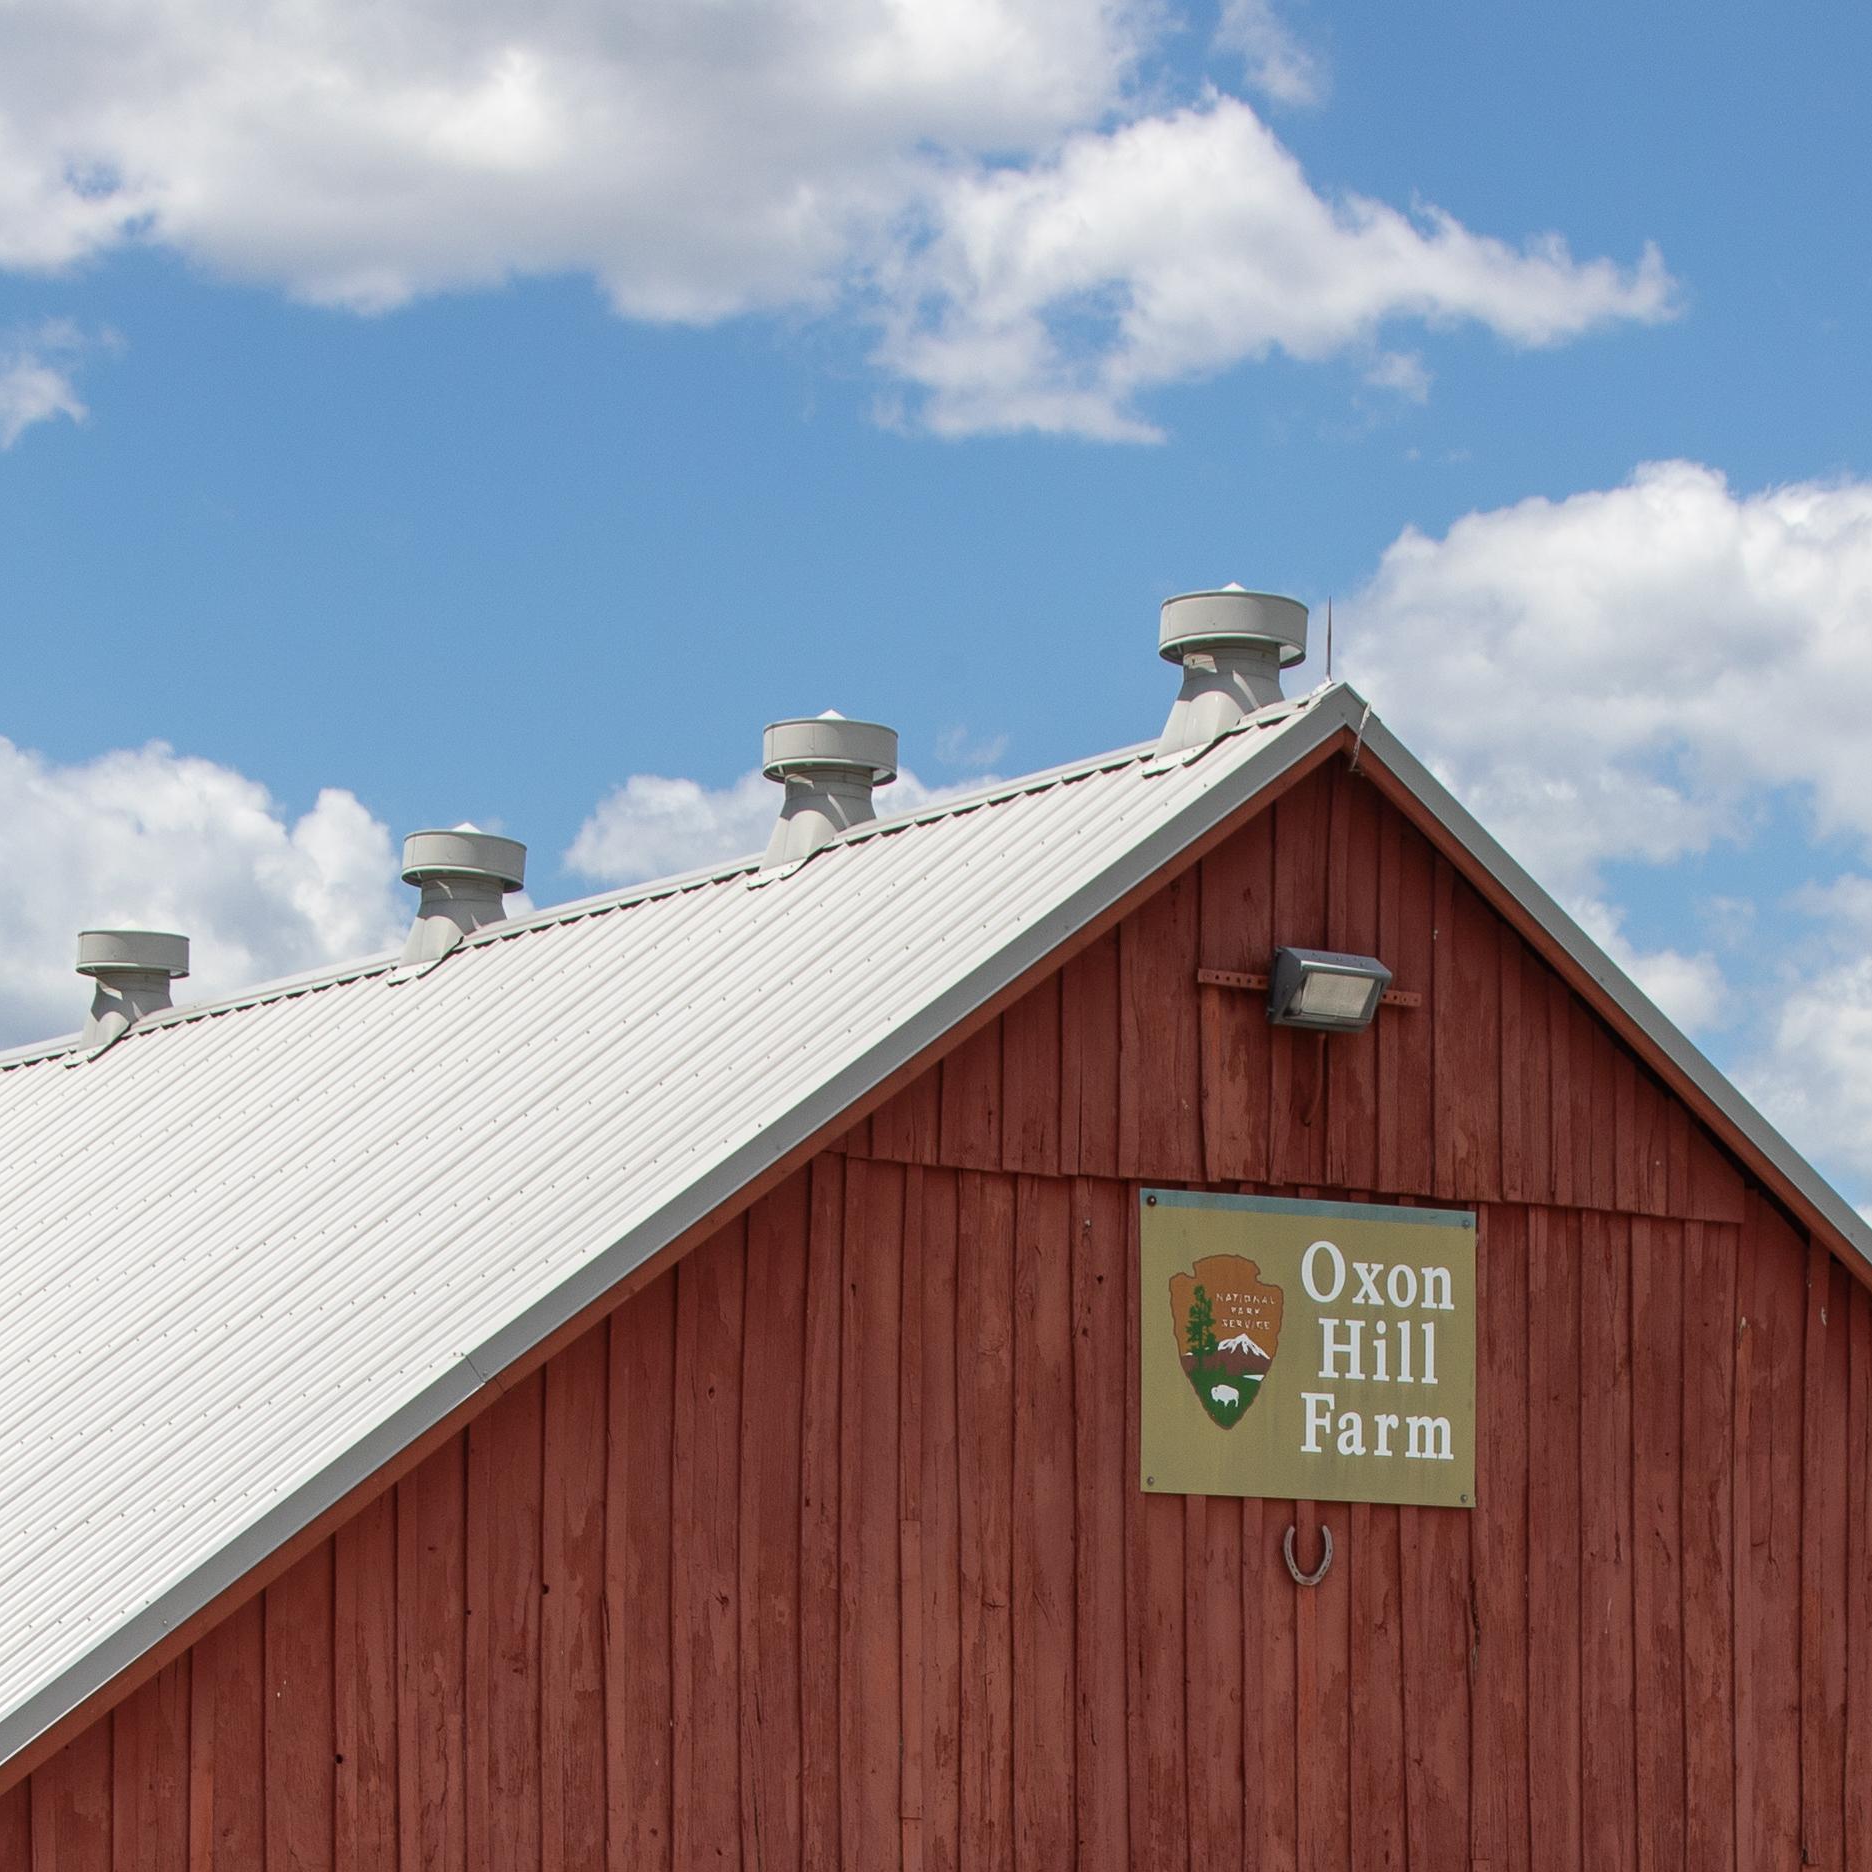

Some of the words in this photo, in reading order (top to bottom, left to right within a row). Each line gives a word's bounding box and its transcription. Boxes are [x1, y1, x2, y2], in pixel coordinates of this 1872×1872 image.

[1300, 1240, 1455, 1311] Oxon
[1215, 1292, 1276, 1305] NATIONAL
[1230, 1305, 1261, 1316] PARK
[1221, 1318, 1271, 1331] SERVICE
[1317, 1317, 1439, 1385] Hill
[1300, 1391, 1455, 1461] Farm
